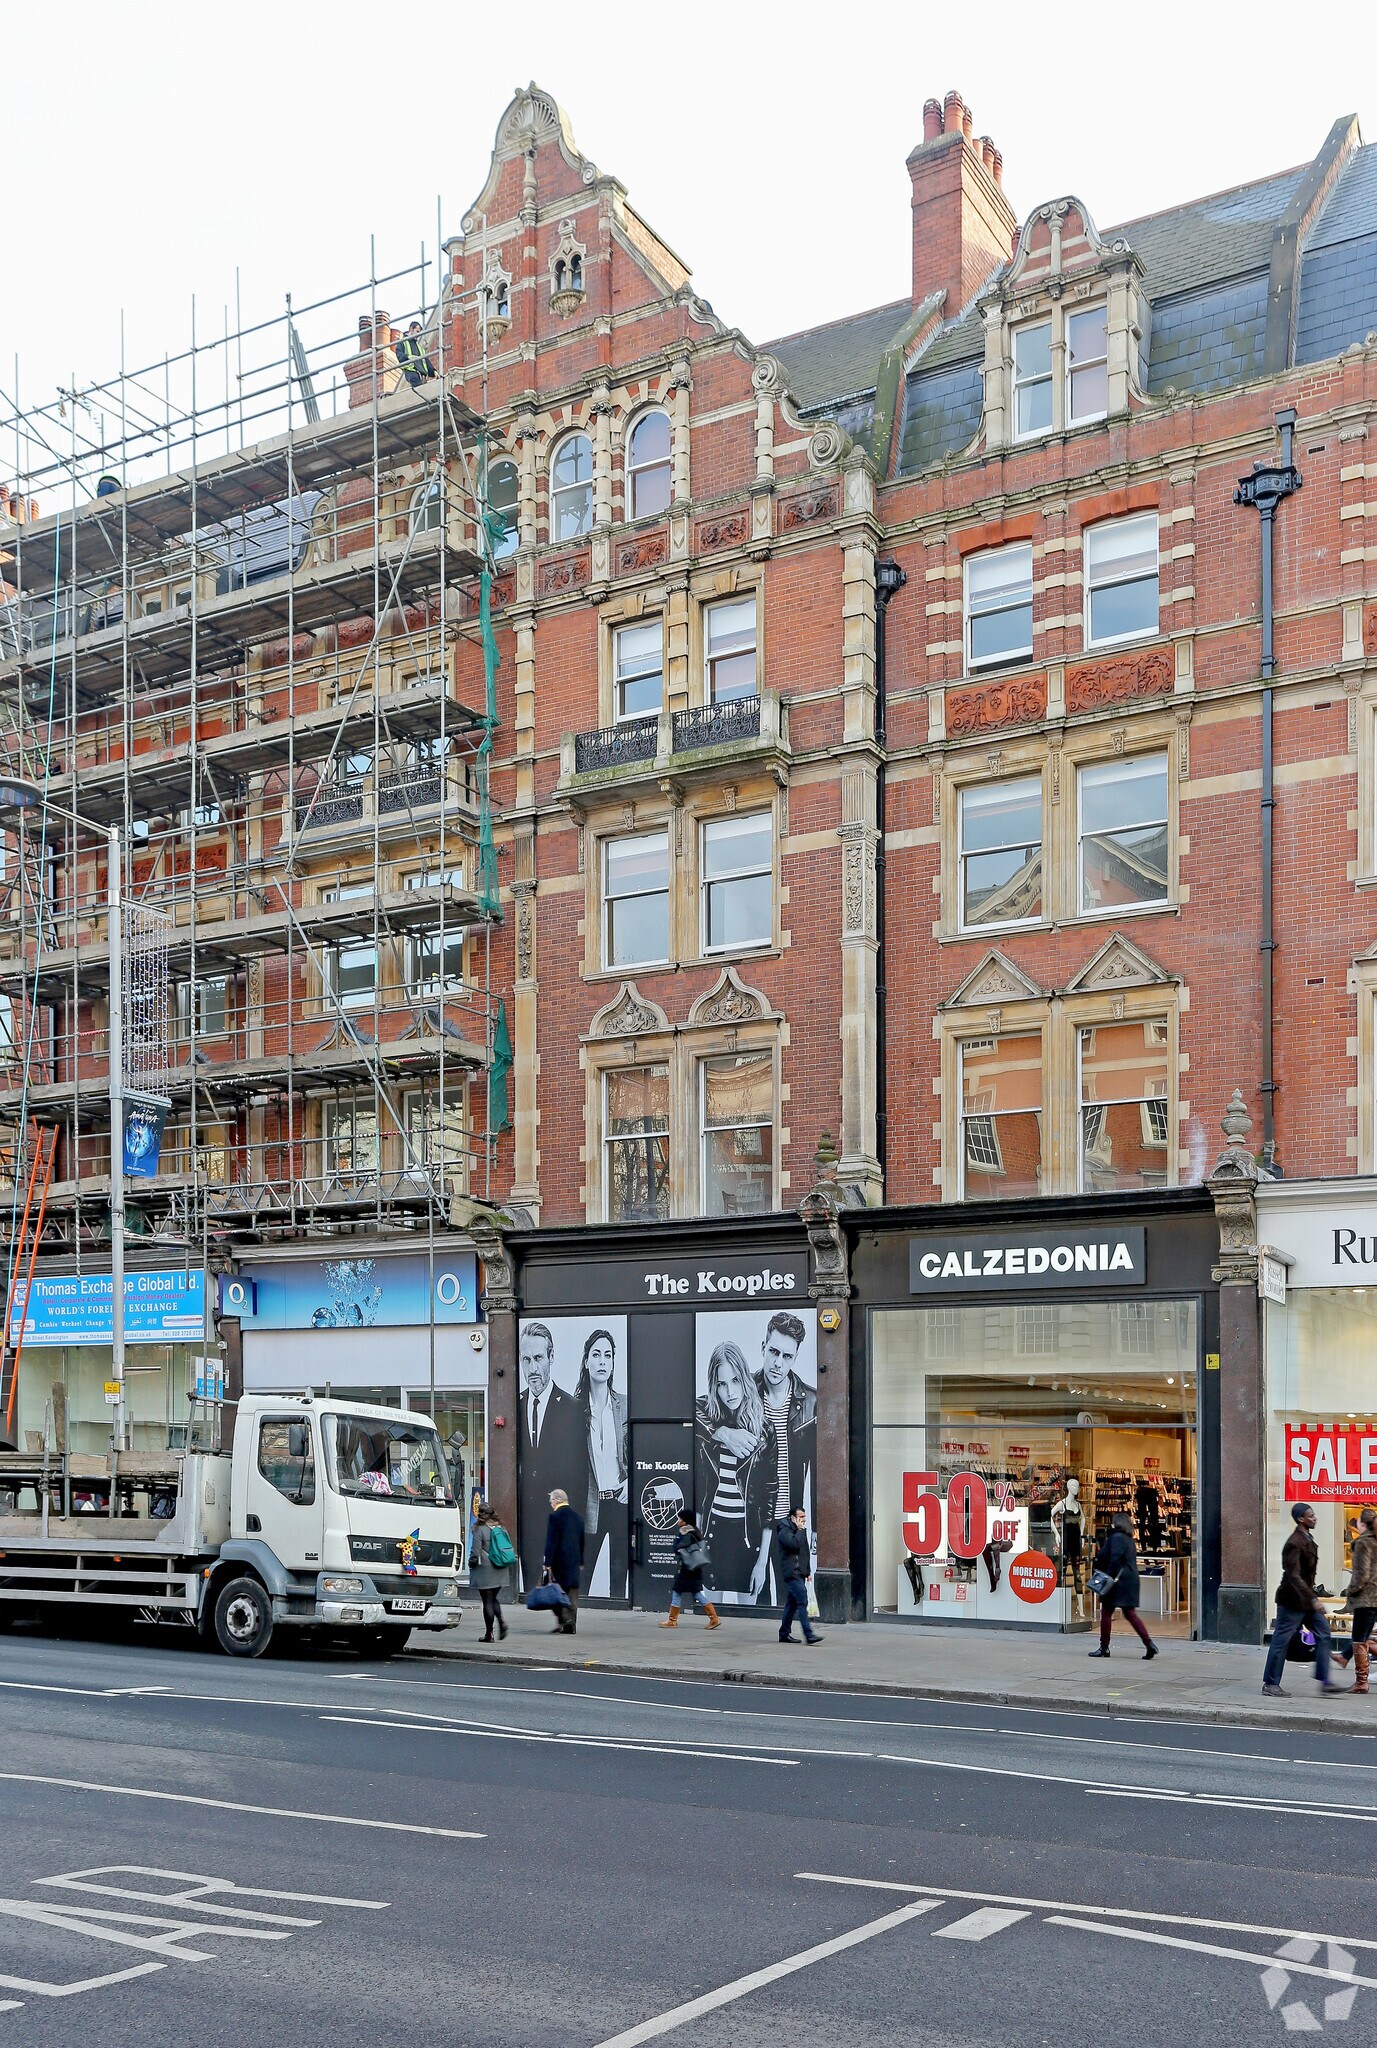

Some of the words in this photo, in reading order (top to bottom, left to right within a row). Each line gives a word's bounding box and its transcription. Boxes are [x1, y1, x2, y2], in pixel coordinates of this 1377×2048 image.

[918, 1242, 1134, 1279] CALZEDONIA
[35, 1281, 77, 1296] Thomas
[81, 1279, 134, 1295] Exchae
[138, 1275, 174, 1292] Global
[178, 1274, 200, 1290] Ld.
[644, 1273, 690, 1295] The
[697, 1269, 796, 1296] Kooples
[47, 1306, 85, 1315] WORLD'S
[88, 1305, 126, 1314] FOREI
[129, 1302, 178, 1312] EXCHANGE
[354, 1407, 374, 1415] TRUCK
[1290, 1437, 1377, 1482] SALE
[636, 1461, 653, 1470] The
[655, 1461, 689, 1472] Kooples
[352, 1541, 382, 1550] DAF
[441, 1548, 453, 1556] LF
[916, 1557, 934, 1565] selected
[946, 1557, 955, 1565] only
[1012, 1566, 1033, 1577] MORE
[1034, 1567, 1054, 1579] LINES
[1020, 1577, 1045, 1589] ADDED
[394, 1600, 411, 1608] WJ52
[411, 1601, 423, 1609] HGE
